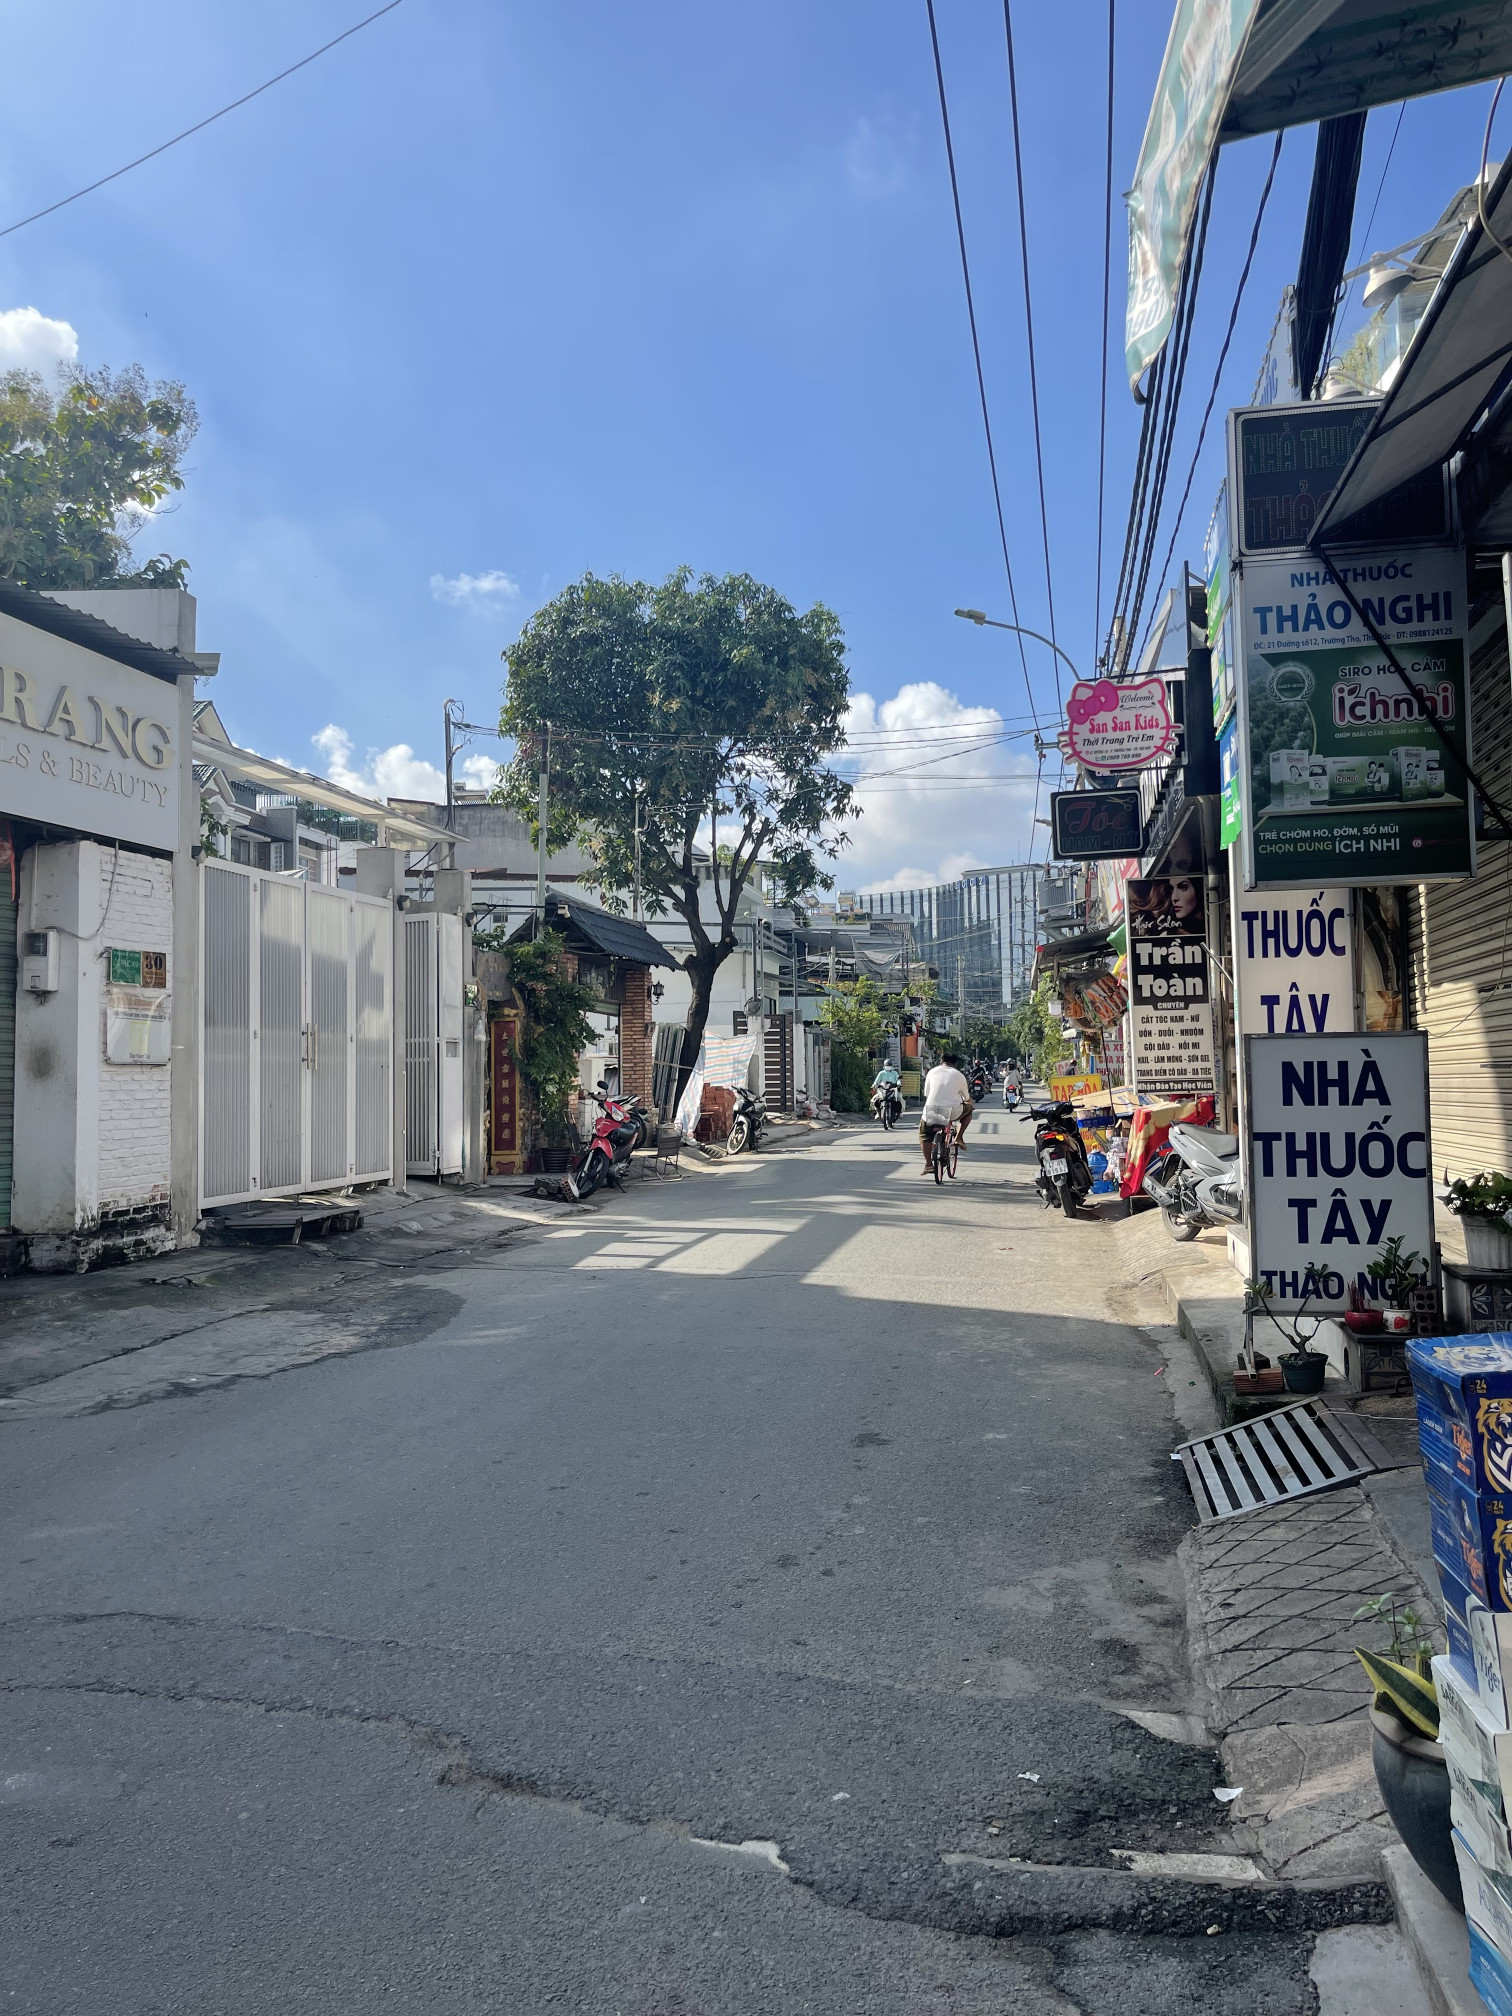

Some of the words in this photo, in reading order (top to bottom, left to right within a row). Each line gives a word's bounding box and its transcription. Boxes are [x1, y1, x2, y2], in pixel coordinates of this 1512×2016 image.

[1244, 422, 1296, 475] NHÀ
[1300, 411, 1367, 470] THUỐ
[1290, 566, 1336, 588] NHÀ
[1338, 559, 1413, 584] THUỐC
[1252, 593, 1352, 635] THẢO
[1361, 590, 1453, 628] NGHI
[1267, 641, 1276, 649] 21
[1321, 636, 1345, 646] Trường
[1409, 628, 1453, 638] 0988124125
[1339, 665, 1372, 679] SIRO
[1376, 663, 1398, 677] HO
[1411, 656, 1447, 673] CẢM
[1120, 692, 1154, 704] Welcome
[0, 664, 176, 770] RANG
[1089, 717, 1108, 735] San
[1112, 716, 1131, 732] San
[1134, 713, 1160, 731] Kids
[1082, 735, 1099, 748] Thời
[1101, 734, 1124, 746] Trang
[1126, 732, 1140, 743] Trẻ
[1140, 733, 1155, 742] Em
[40, 749, 58, 777] &
[69, 756, 168, 808] BEAUTY
[1065, 801, 1129, 834] Tóc
[1259, 829, 1278, 841] TRẺ
[1280, 828, 1311, 840] CHỚM
[1313, 828, 1331, 839] HO,
[1333, 825, 1361, 837] ĐỜM,
[1379, 824, 1399, 835] MŨI
[1258, 843, 1294, 855] CHỌN
[1297, 840, 1333, 852] DÙNG
[1335, 838, 1365, 855] ÍCH
[1369, 838, 1400, 851] NHI
[1131, 913, 1155, 936] Hair
[1156, 914, 1182, 930] Salon
[1241, 891, 1347, 959] THUỐC
[145, 954, 163, 971] 30
[1135, 938, 1202, 966] Trần
[1137, 973, 1204, 998] Toàn
[1157, 1001, 1185, 1009] CHUYÊN
[1260, 981, 1331, 1033] TÂY
[1155, 1014, 1168, 1024] TÓC
[1170, 1015, 1184, 1023] NAM
[1144, 1041, 1155, 1053] GỘI
[1192, 1041, 1200, 1050] MI
[1138, 1056, 1149, 1064] NAIL
[1154, 1054, 1165, 1064] LÀM
[1167, 1054, 1183, 1063] MÓNG
[1201, 1054, 1210, 1063] GEL
[1137, 1069, 1153, 1077] TRANG
[1281, 1049, 1392, 1107] NHÀ
[1182, 1082, 1196, 1090] Học
[1197, 1081, 1212, 1089] Viên
[1253, 1114, 1427, 1179] THUỐC
[1287, 1187, 1393, 1245] TÂY
[1259, 1261, 1345, 1300] THẢO
[1475, 1379, 1487, 1389] 24
[1452, 1423, 1472, 1461] Tiger
[1492, 1500, 1504, 1510] 24
[1480, 1653, 1501, 1694] Tiger
